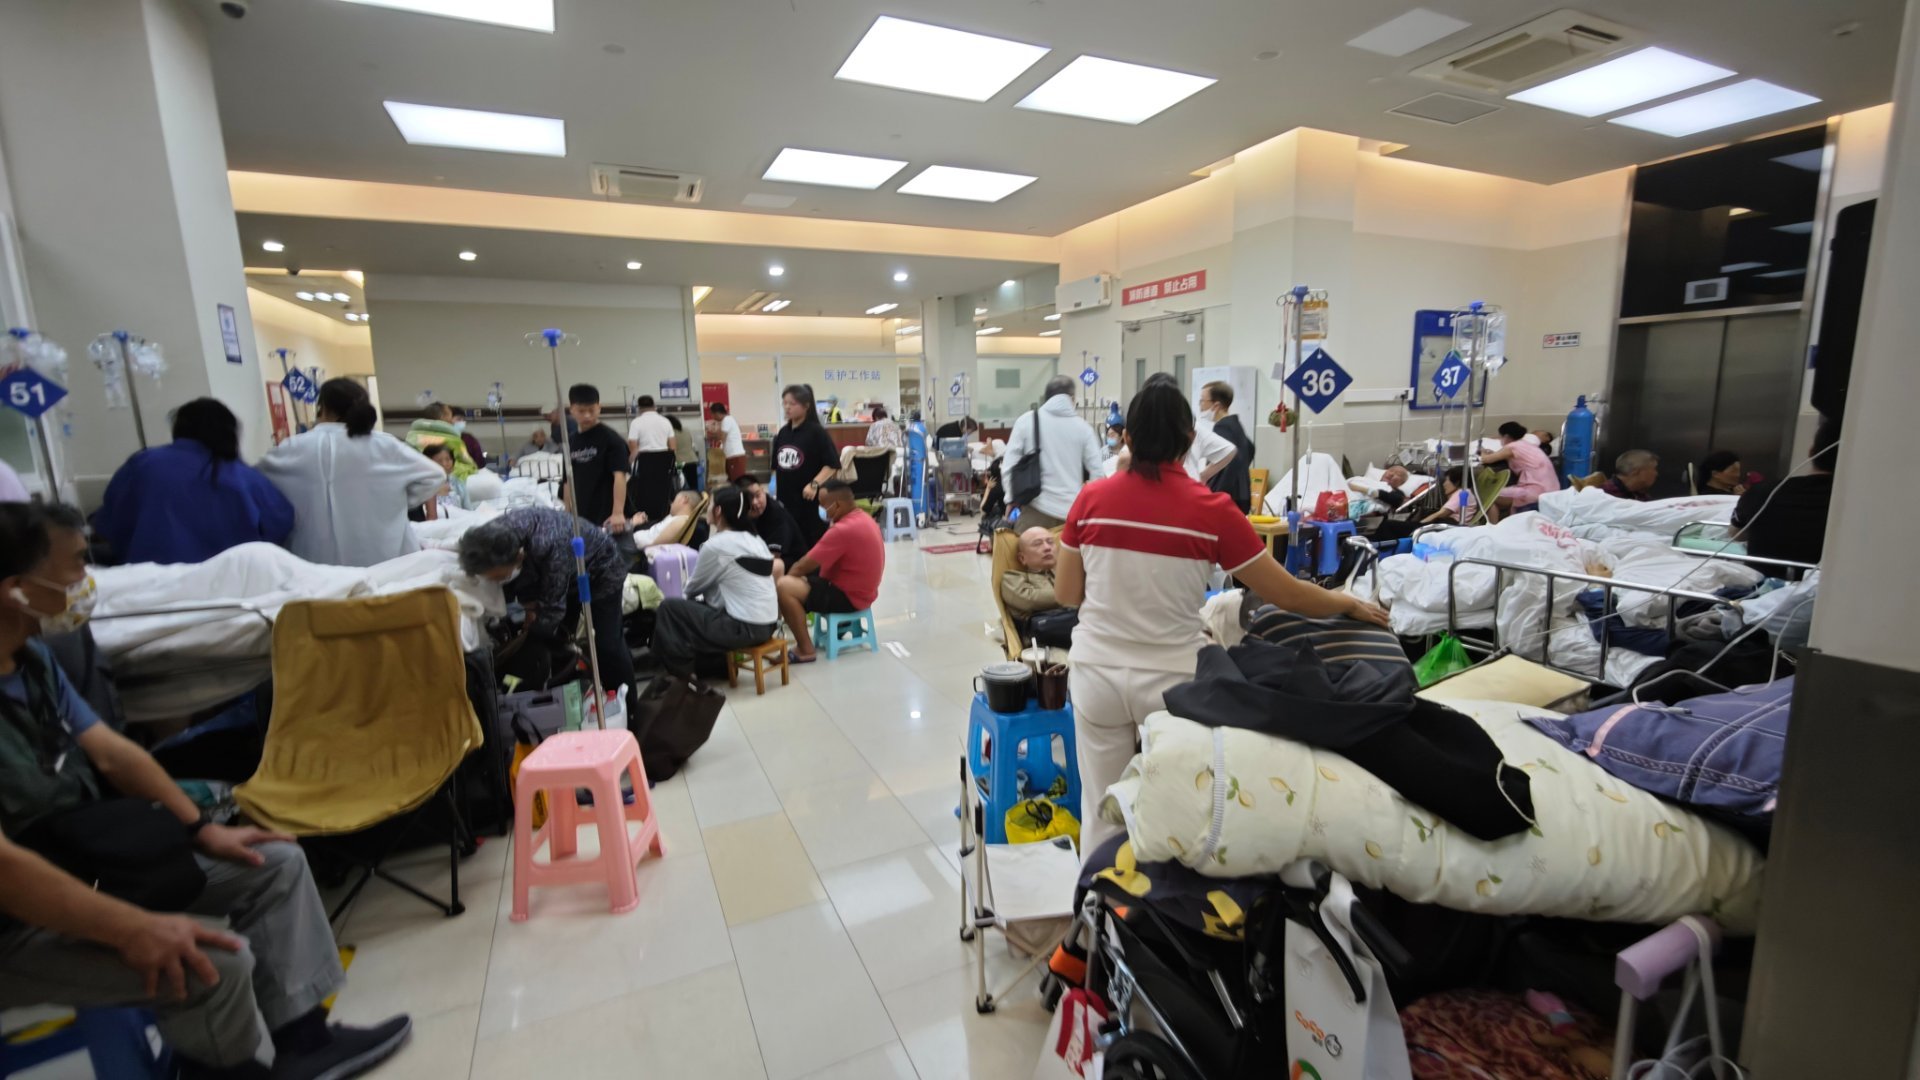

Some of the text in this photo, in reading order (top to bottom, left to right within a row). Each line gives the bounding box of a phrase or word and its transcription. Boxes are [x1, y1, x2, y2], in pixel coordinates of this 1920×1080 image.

[289, 375, 306, 393] 52
[824, 369, 881, 382] 医护工作站
[1302, 369, 1336, 396] 36
[1441, 365, 1461, 387] 37
[10, 381, 46, 406] 51
